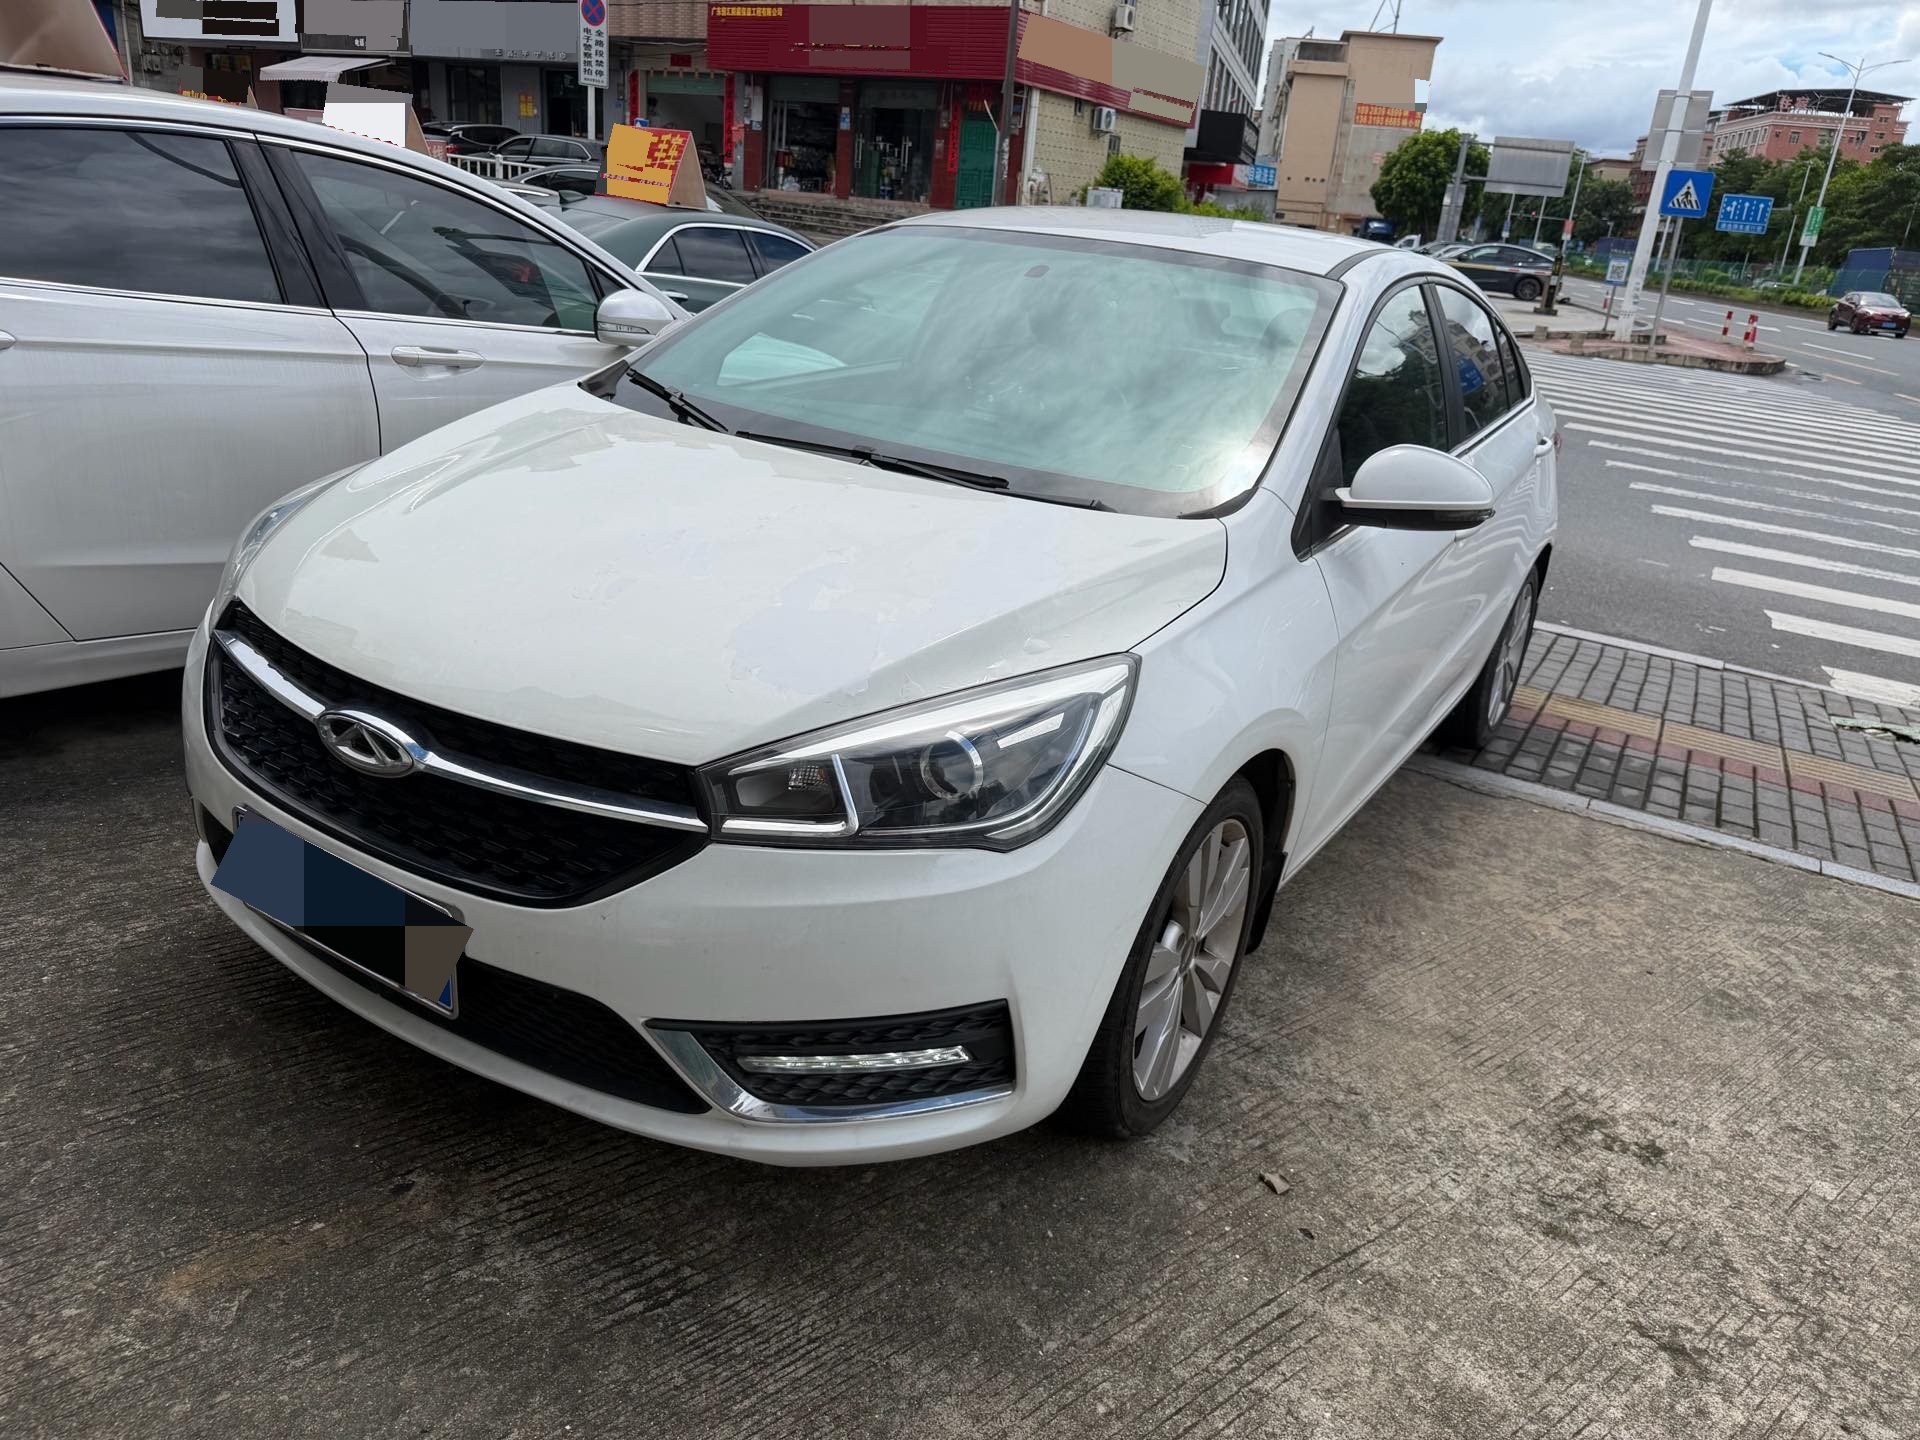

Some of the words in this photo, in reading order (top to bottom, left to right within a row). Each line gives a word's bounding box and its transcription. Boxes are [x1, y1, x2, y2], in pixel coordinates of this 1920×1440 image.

[582, 27, 593, 76] 电子警察抓拍
[594, 29, 605, 78] 全路段禁停
